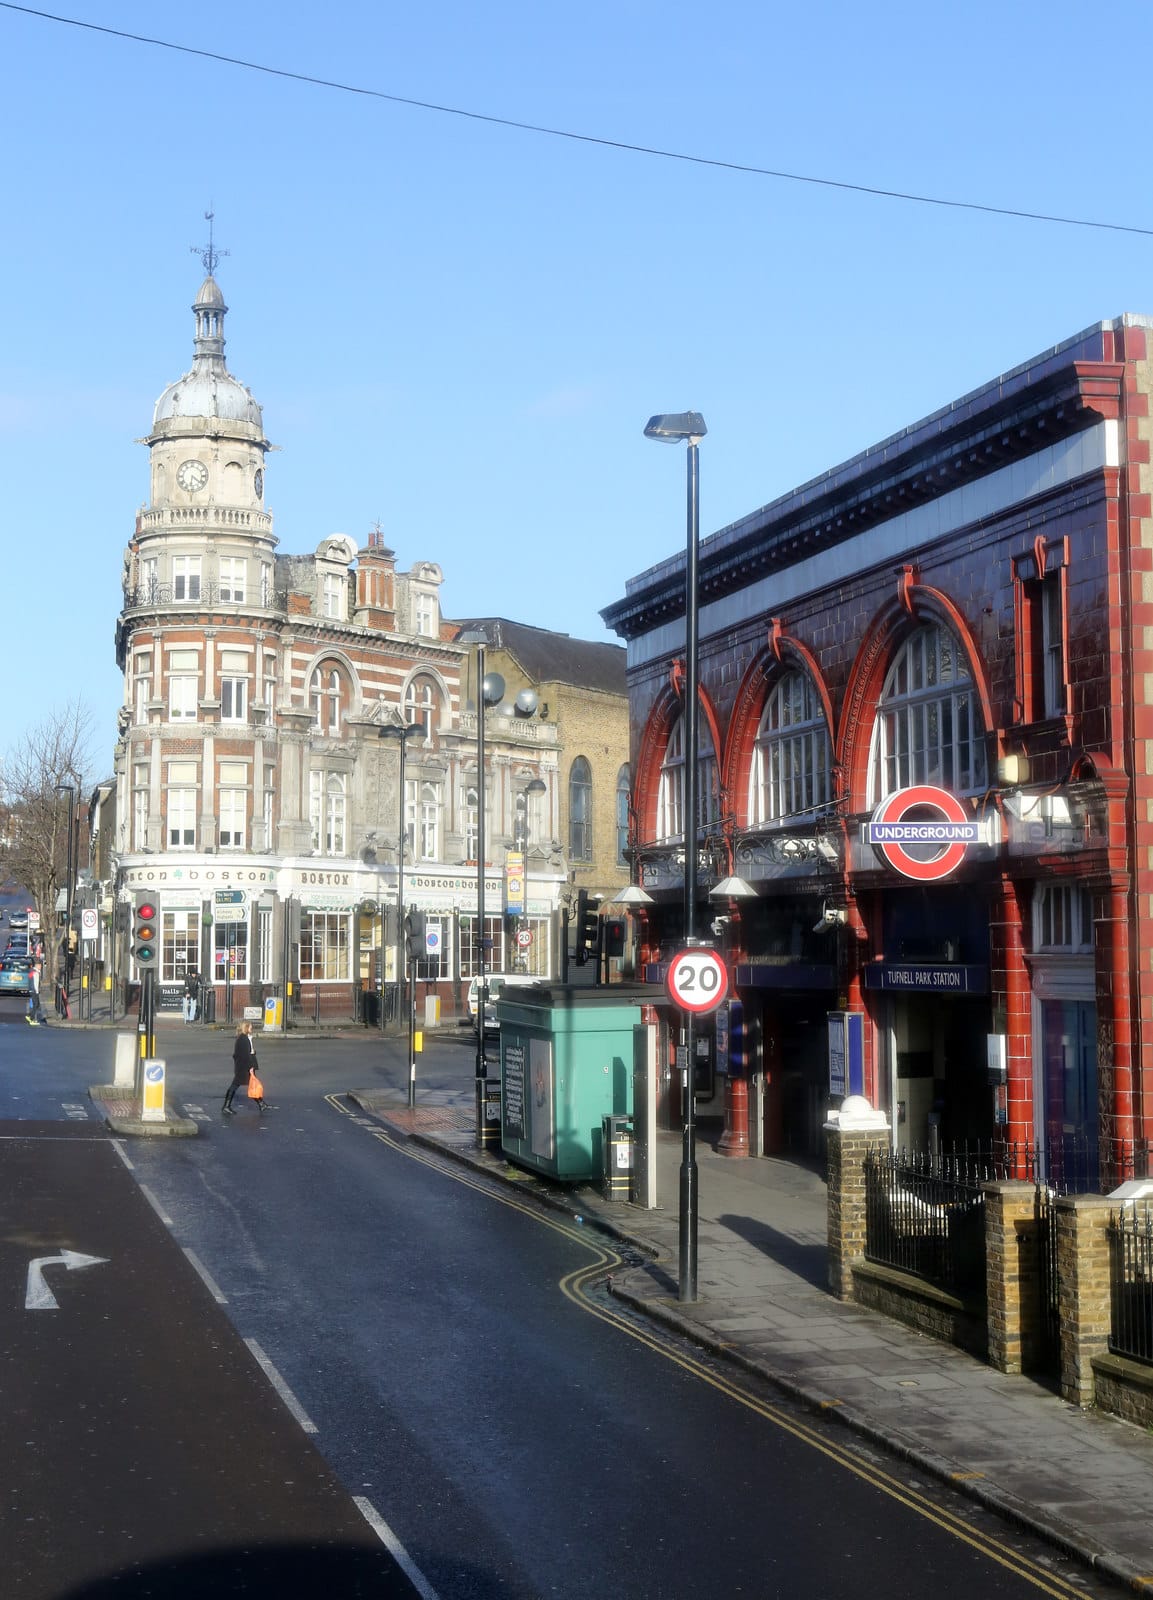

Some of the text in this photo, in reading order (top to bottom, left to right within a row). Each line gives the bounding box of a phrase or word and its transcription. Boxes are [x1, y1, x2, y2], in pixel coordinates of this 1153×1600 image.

[874, 826, 975, 839] UNDERGROUND
[189, 869, 266, 881] boston
[301, 872, 349, 885] BOSTON
[417, 877, 497, 890] boston boson
[678, 965, 718, 992] 20
[887, 970, 961, 986] TUFNELL PARK STATION
